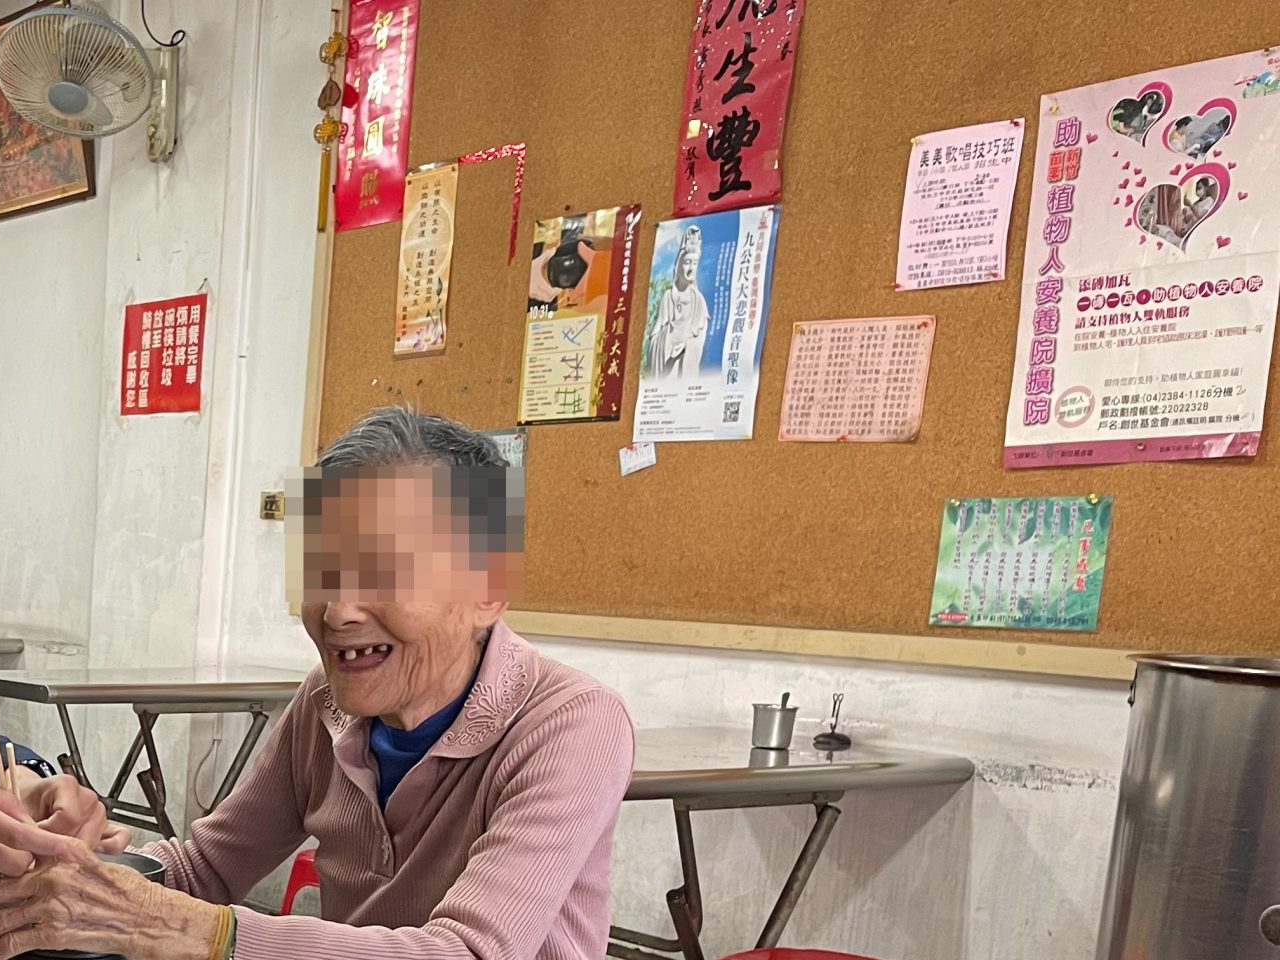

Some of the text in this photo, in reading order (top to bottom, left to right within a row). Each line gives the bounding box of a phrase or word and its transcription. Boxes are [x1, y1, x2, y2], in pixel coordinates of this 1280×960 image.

[920, 137, 1016, 168] 美美歌唱技巧班
[138, 310, 152, 408] 騎樓回收區
[151, 309, 163, 349] 放至
[161, 308, 175, 386] 碗筷垃圾
[175, 306, 188, 366] 煩請將
[186, 304, 200, 385] 用餐完畢
[125, 350, 137, 408] 感謝您
